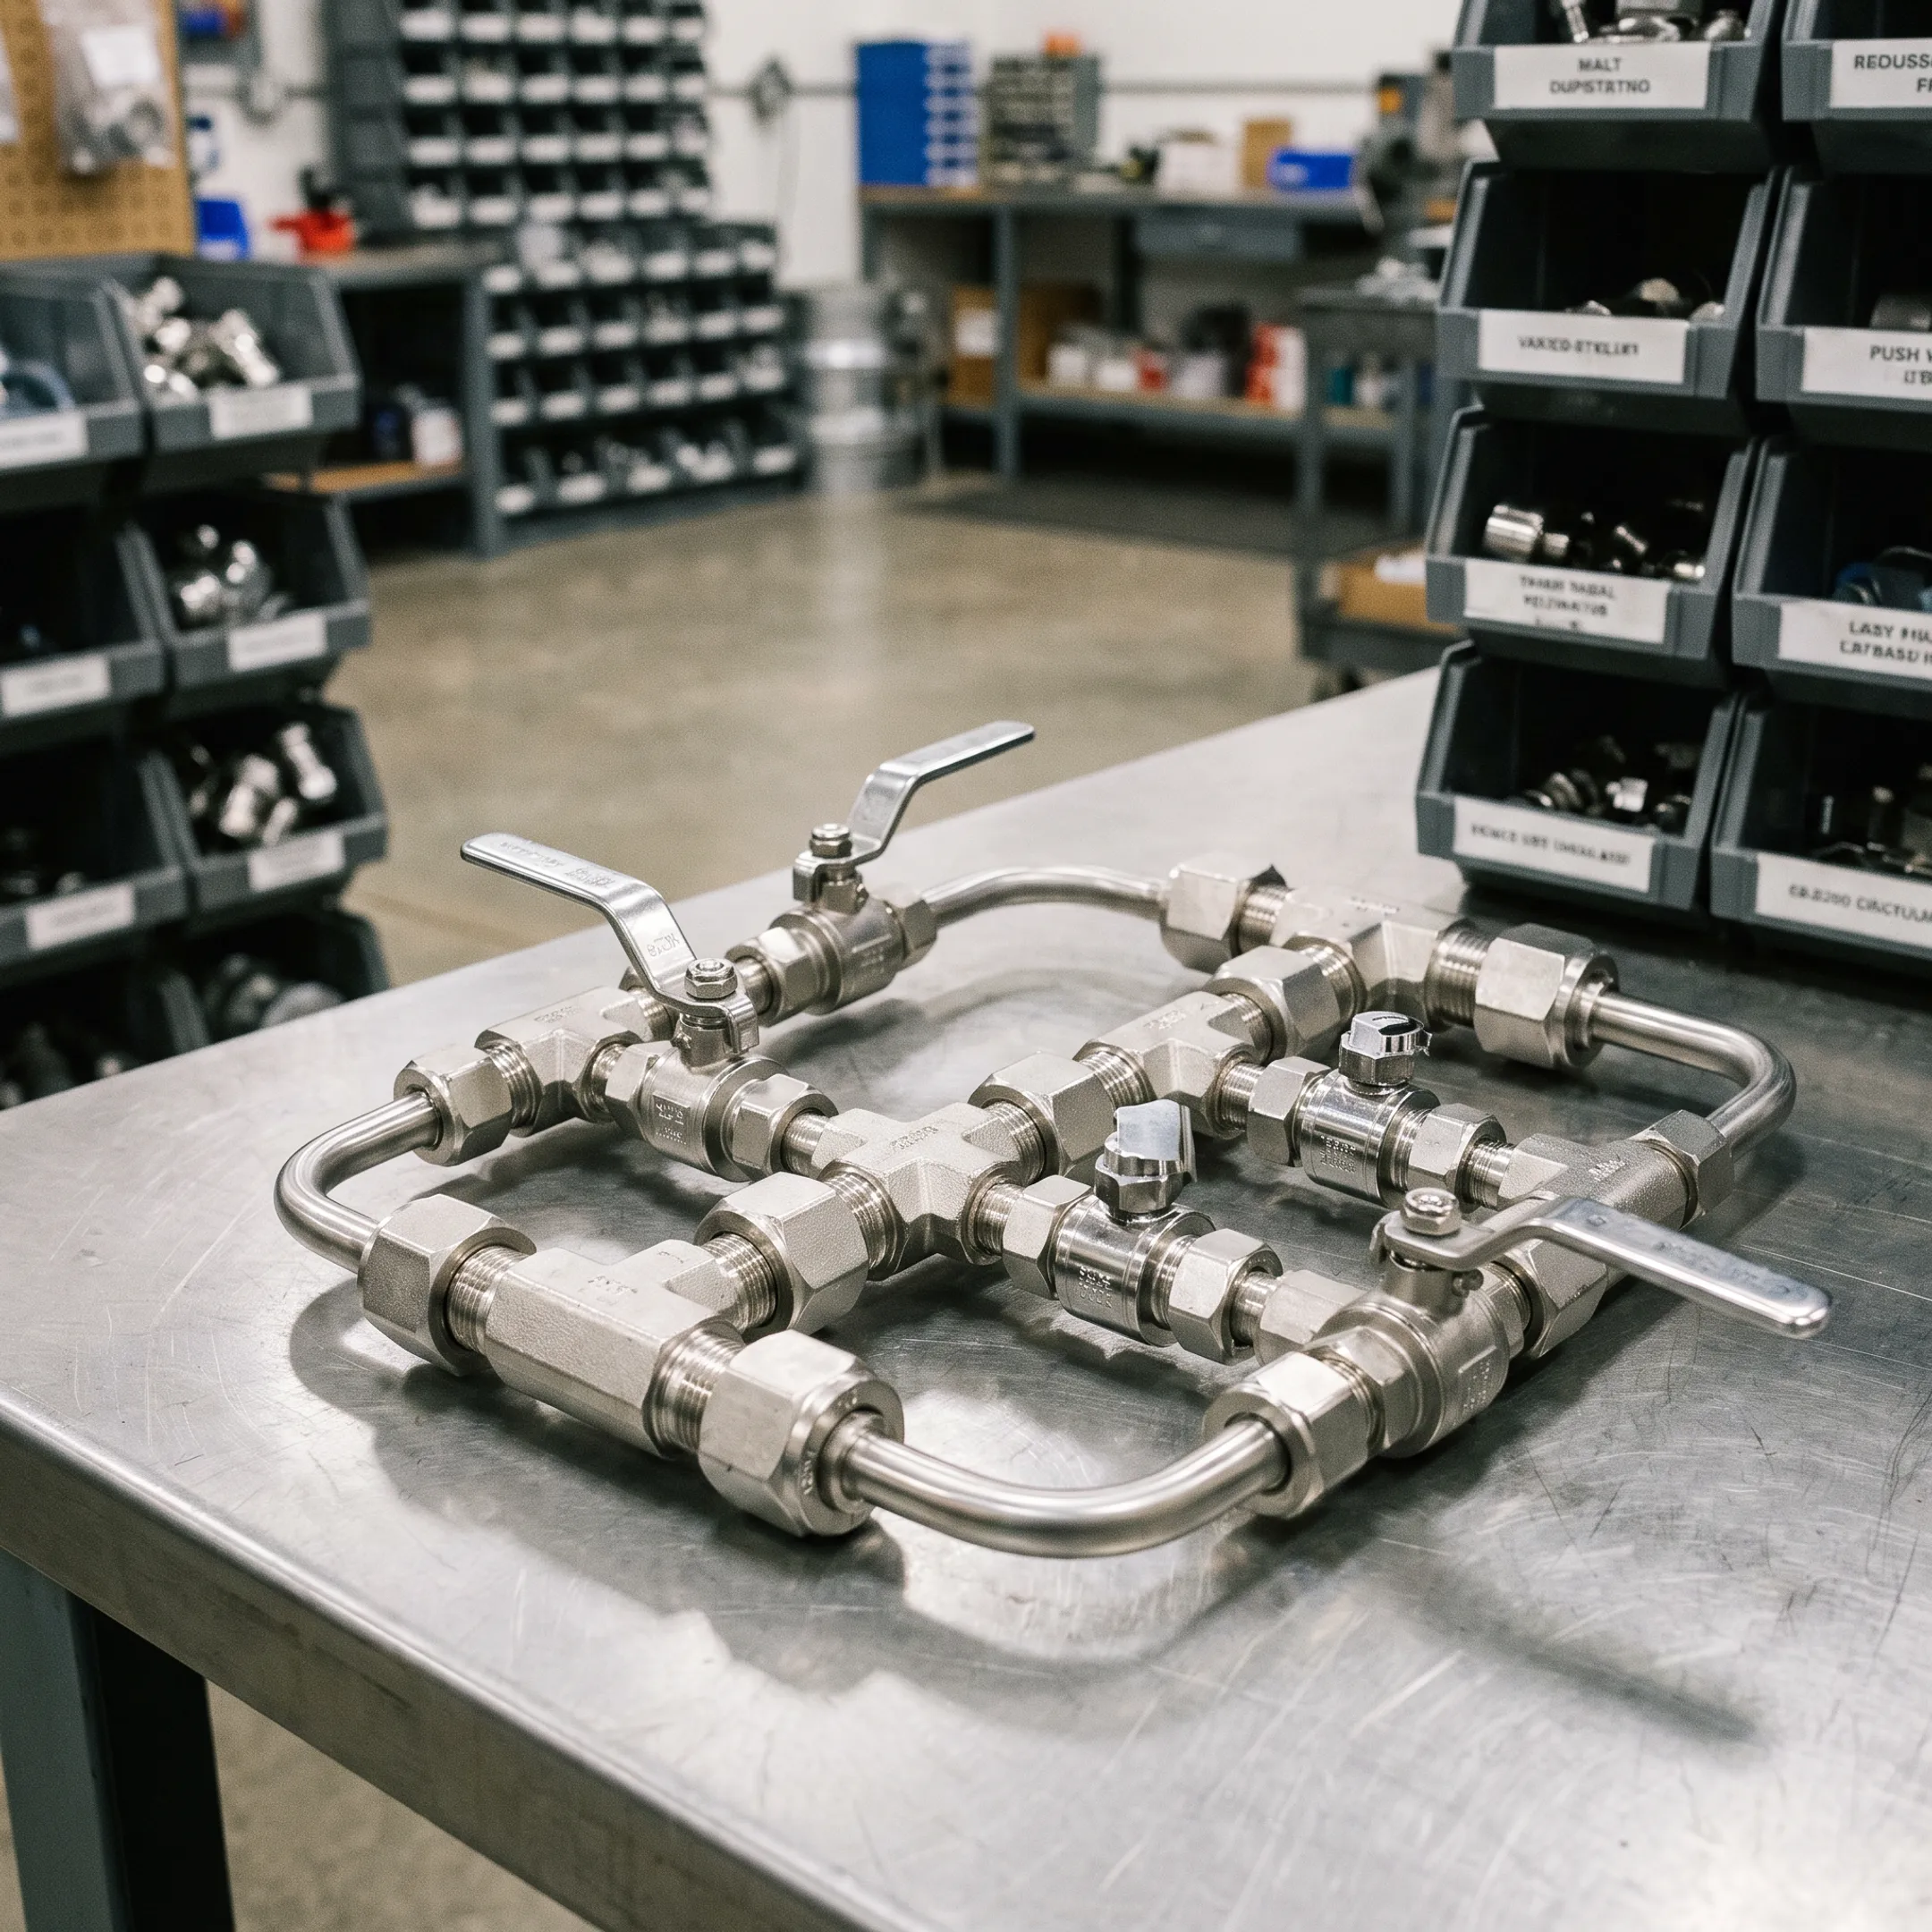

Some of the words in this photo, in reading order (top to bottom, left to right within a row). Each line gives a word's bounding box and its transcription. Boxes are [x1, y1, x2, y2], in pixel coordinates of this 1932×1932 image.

[1578, 56, 1622, 72] MALT
[1854, 54, 1932, 69] REDUSS
[1870, 344, 1919, 362] PUSH
